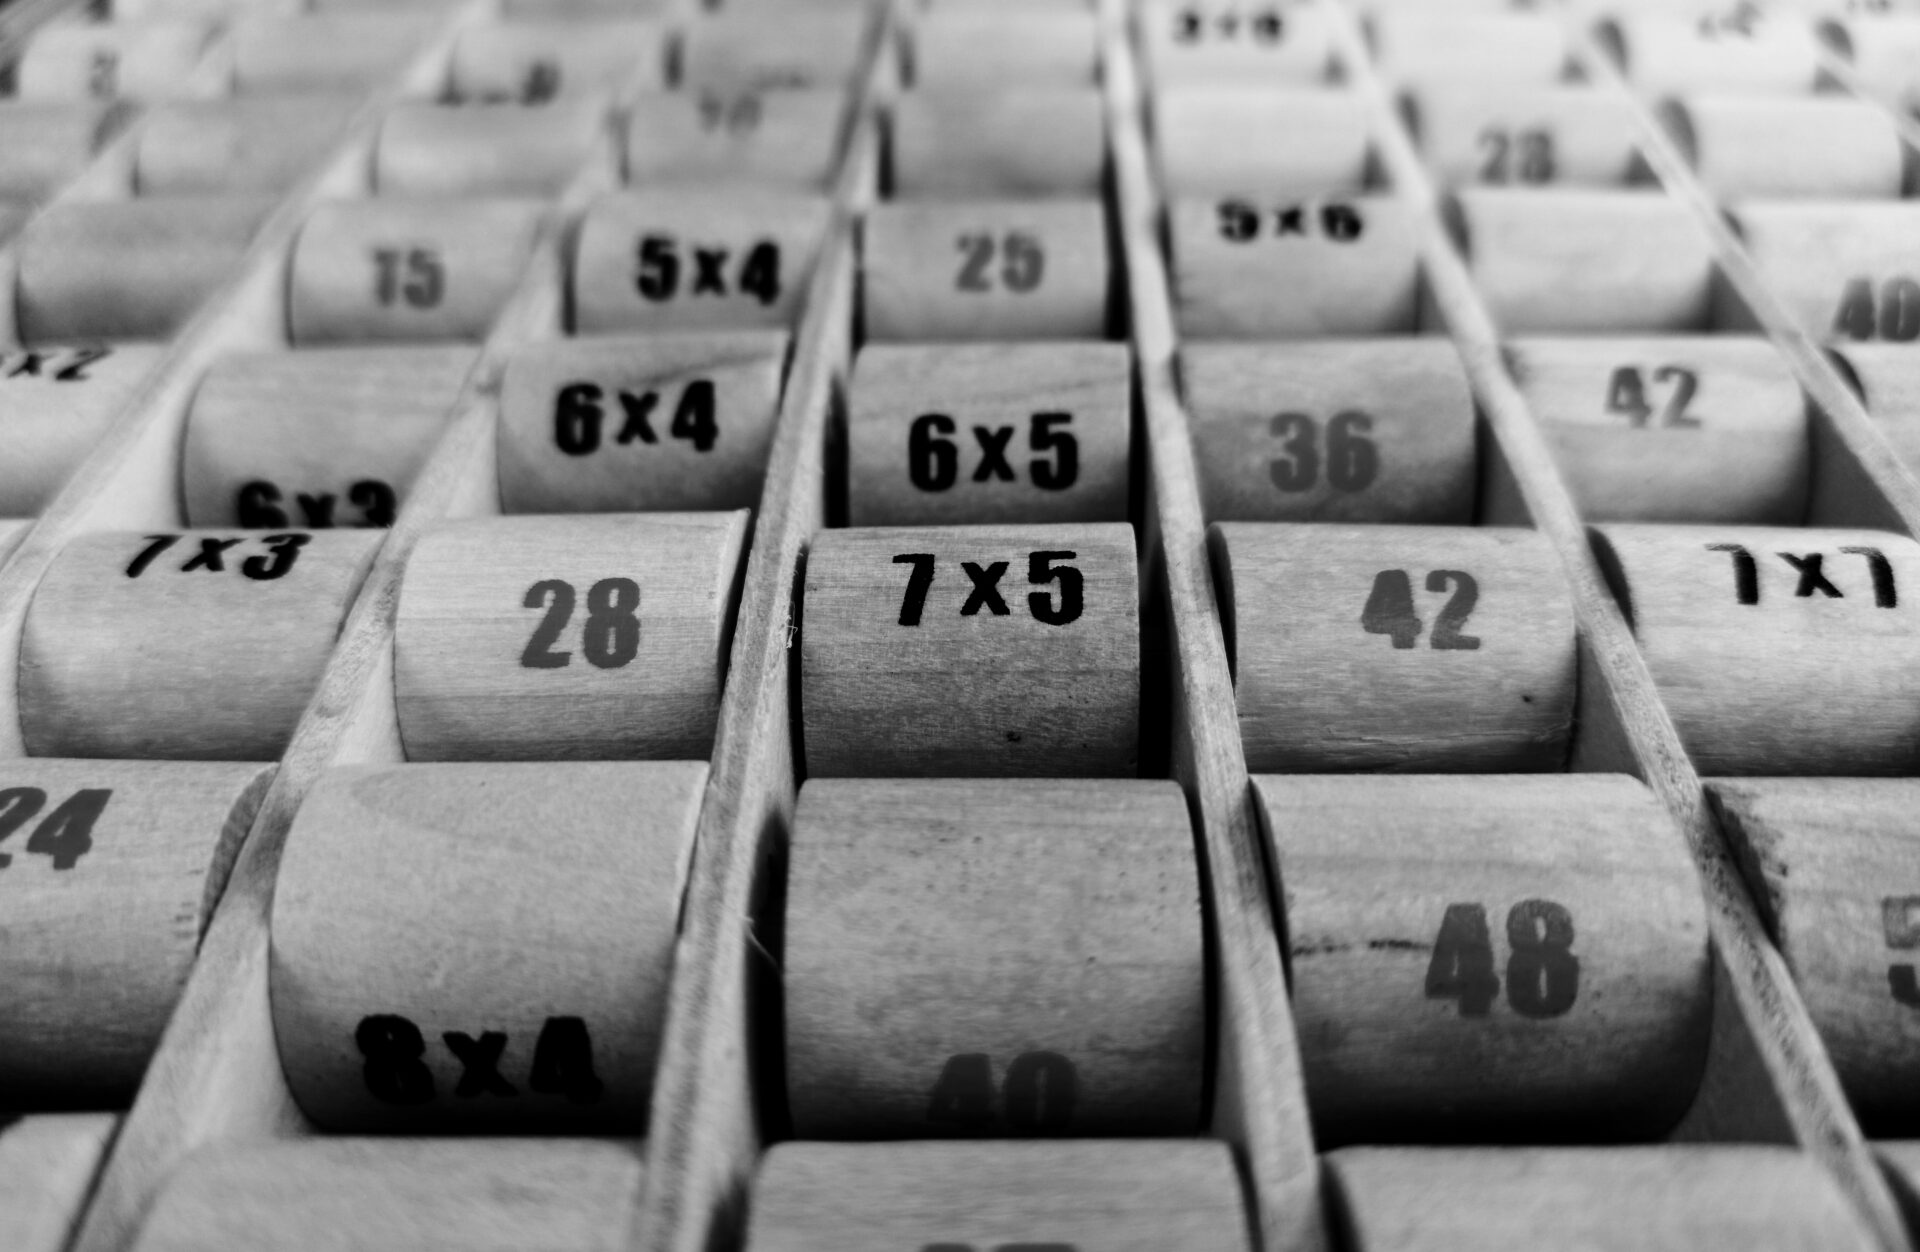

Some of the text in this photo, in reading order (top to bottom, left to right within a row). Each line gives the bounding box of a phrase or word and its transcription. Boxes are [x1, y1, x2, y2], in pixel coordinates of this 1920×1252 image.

[372, 246, 445, 310] 15
[637, 234, 780, 304] 5x4
[955, 233, 1044, 293] 25
[1832, 275, 1920, 342] 40
[553, 378, 719, 456] 6x4
[1605, 365, 1703, 429] 42
[908, 412, 1082, 492] 6x5
[1269, 410, 1380, 493] 36
[126, 533, 312, 580] 7x3
[892, 550, 1084, 626] 7x5
[1704, 543, 1897, 608] 7x7
[519, 577, 641, 668] 28
[1360, 569, 1480, 650] 42
[1424, 899, 1579, 1019] 48
[355, 1013, 605, 1103] 8x4
[926, 1050, 1080, 1130] 40
